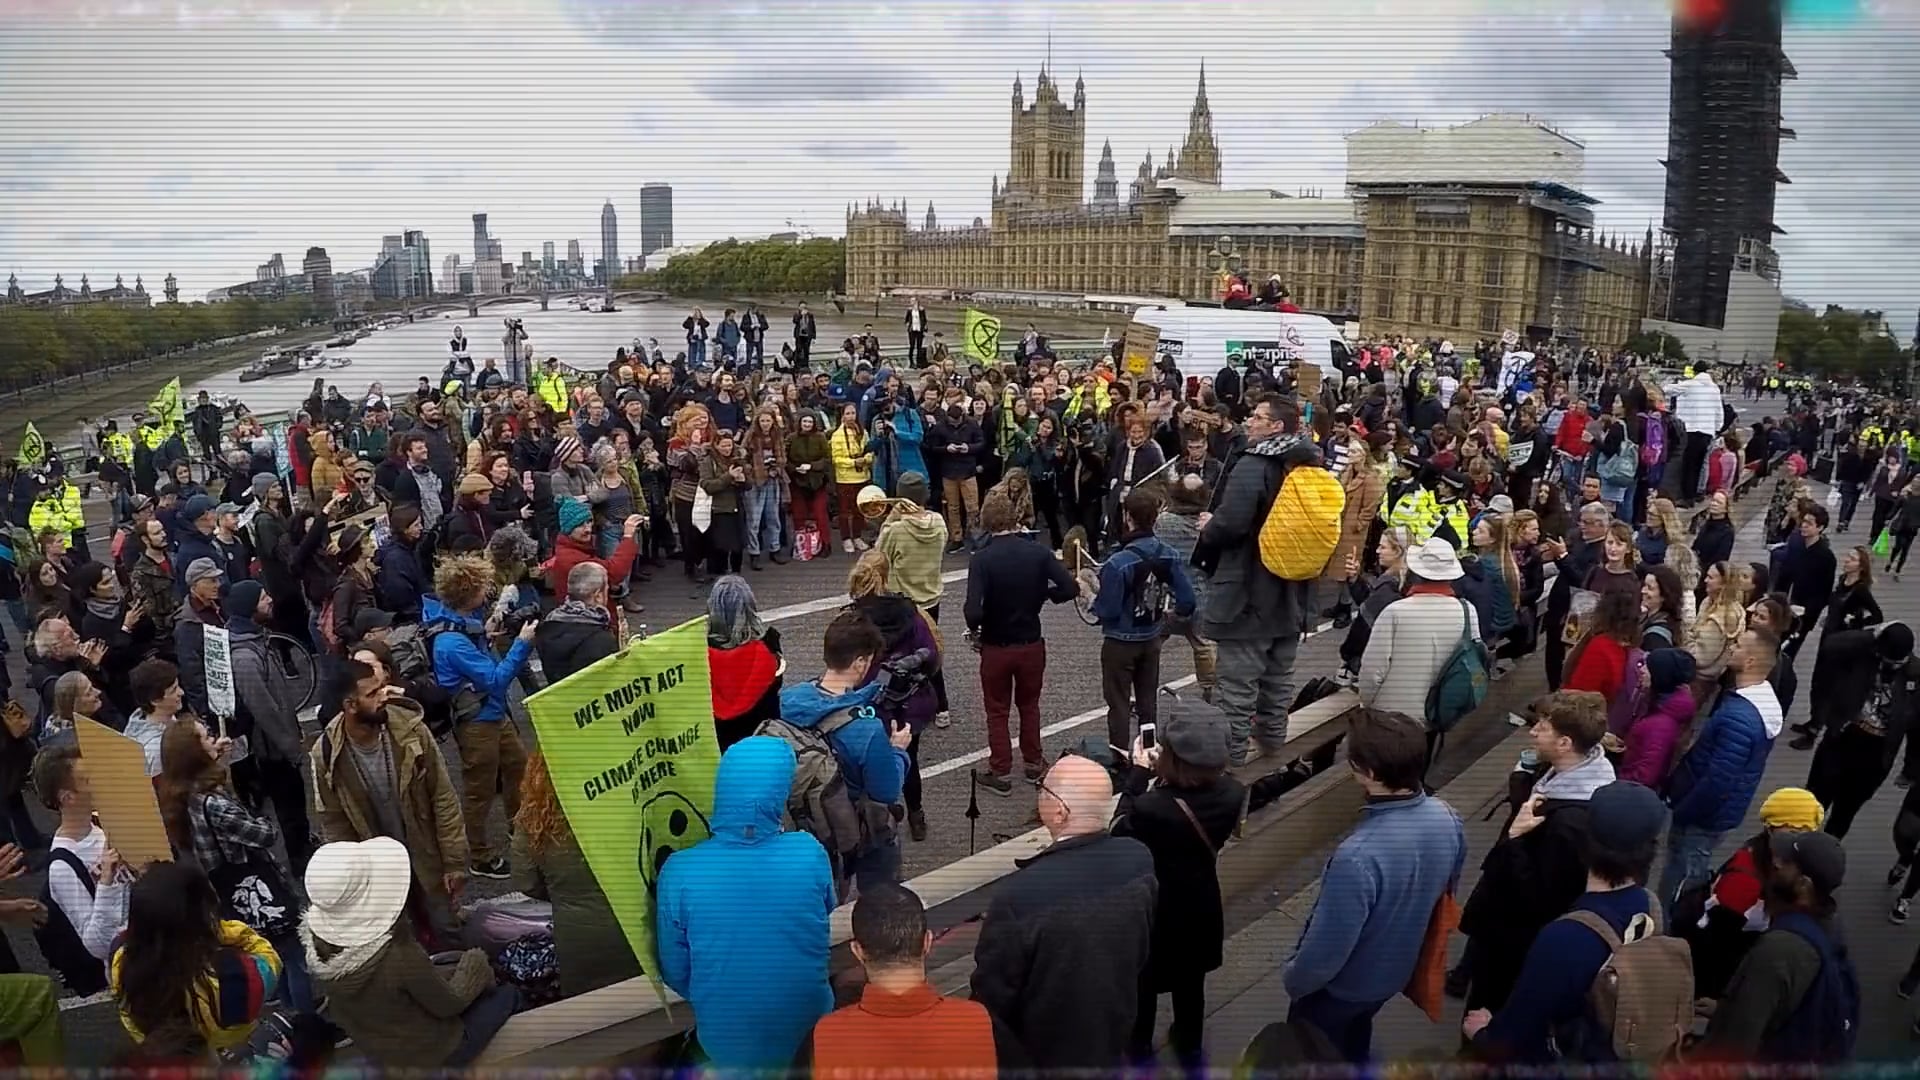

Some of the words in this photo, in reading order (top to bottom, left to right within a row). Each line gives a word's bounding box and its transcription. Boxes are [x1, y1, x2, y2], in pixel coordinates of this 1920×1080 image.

[1156, 341, 1182, 352] prise
[573, 699, 604, 729] WE
[604, 676, 652, 713] MUST
[657, 663, 685, 693] ACT
[621, 702, 655, 736] NOW
[583, 747, 643, 801] CLIMATE
[645, 722, 700, 758] CHANGE
[640, 761, 677, 791] HERE
